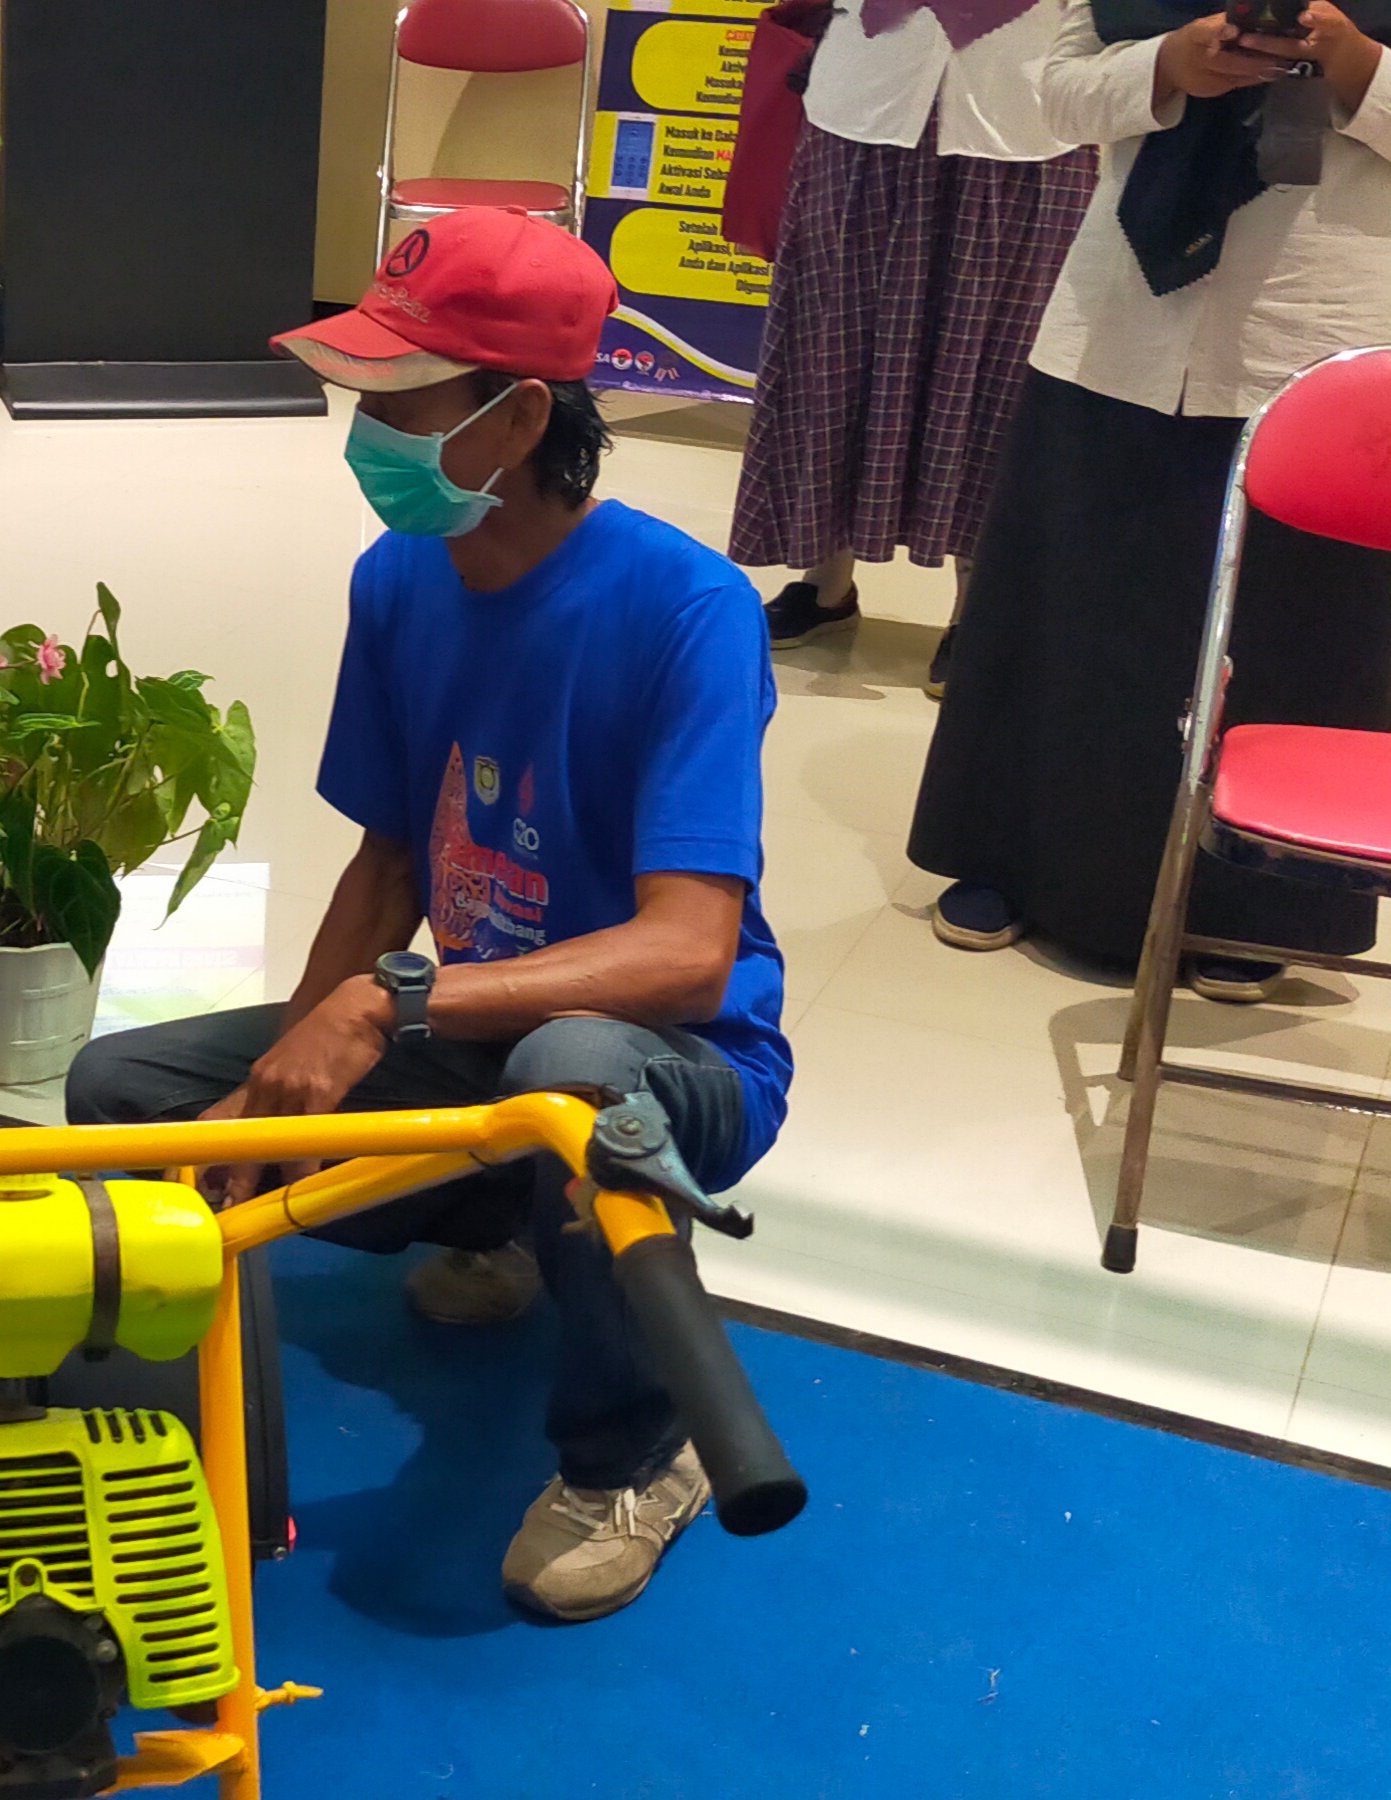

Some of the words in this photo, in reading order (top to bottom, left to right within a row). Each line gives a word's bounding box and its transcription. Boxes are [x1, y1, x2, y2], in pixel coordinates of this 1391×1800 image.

[665, 126, 698, 140] Masuk
[701, 128, 713, 141] ke
[660, 164, 702, 178] Aktivasi
[728, 261, 770, 276] Aplikasi
